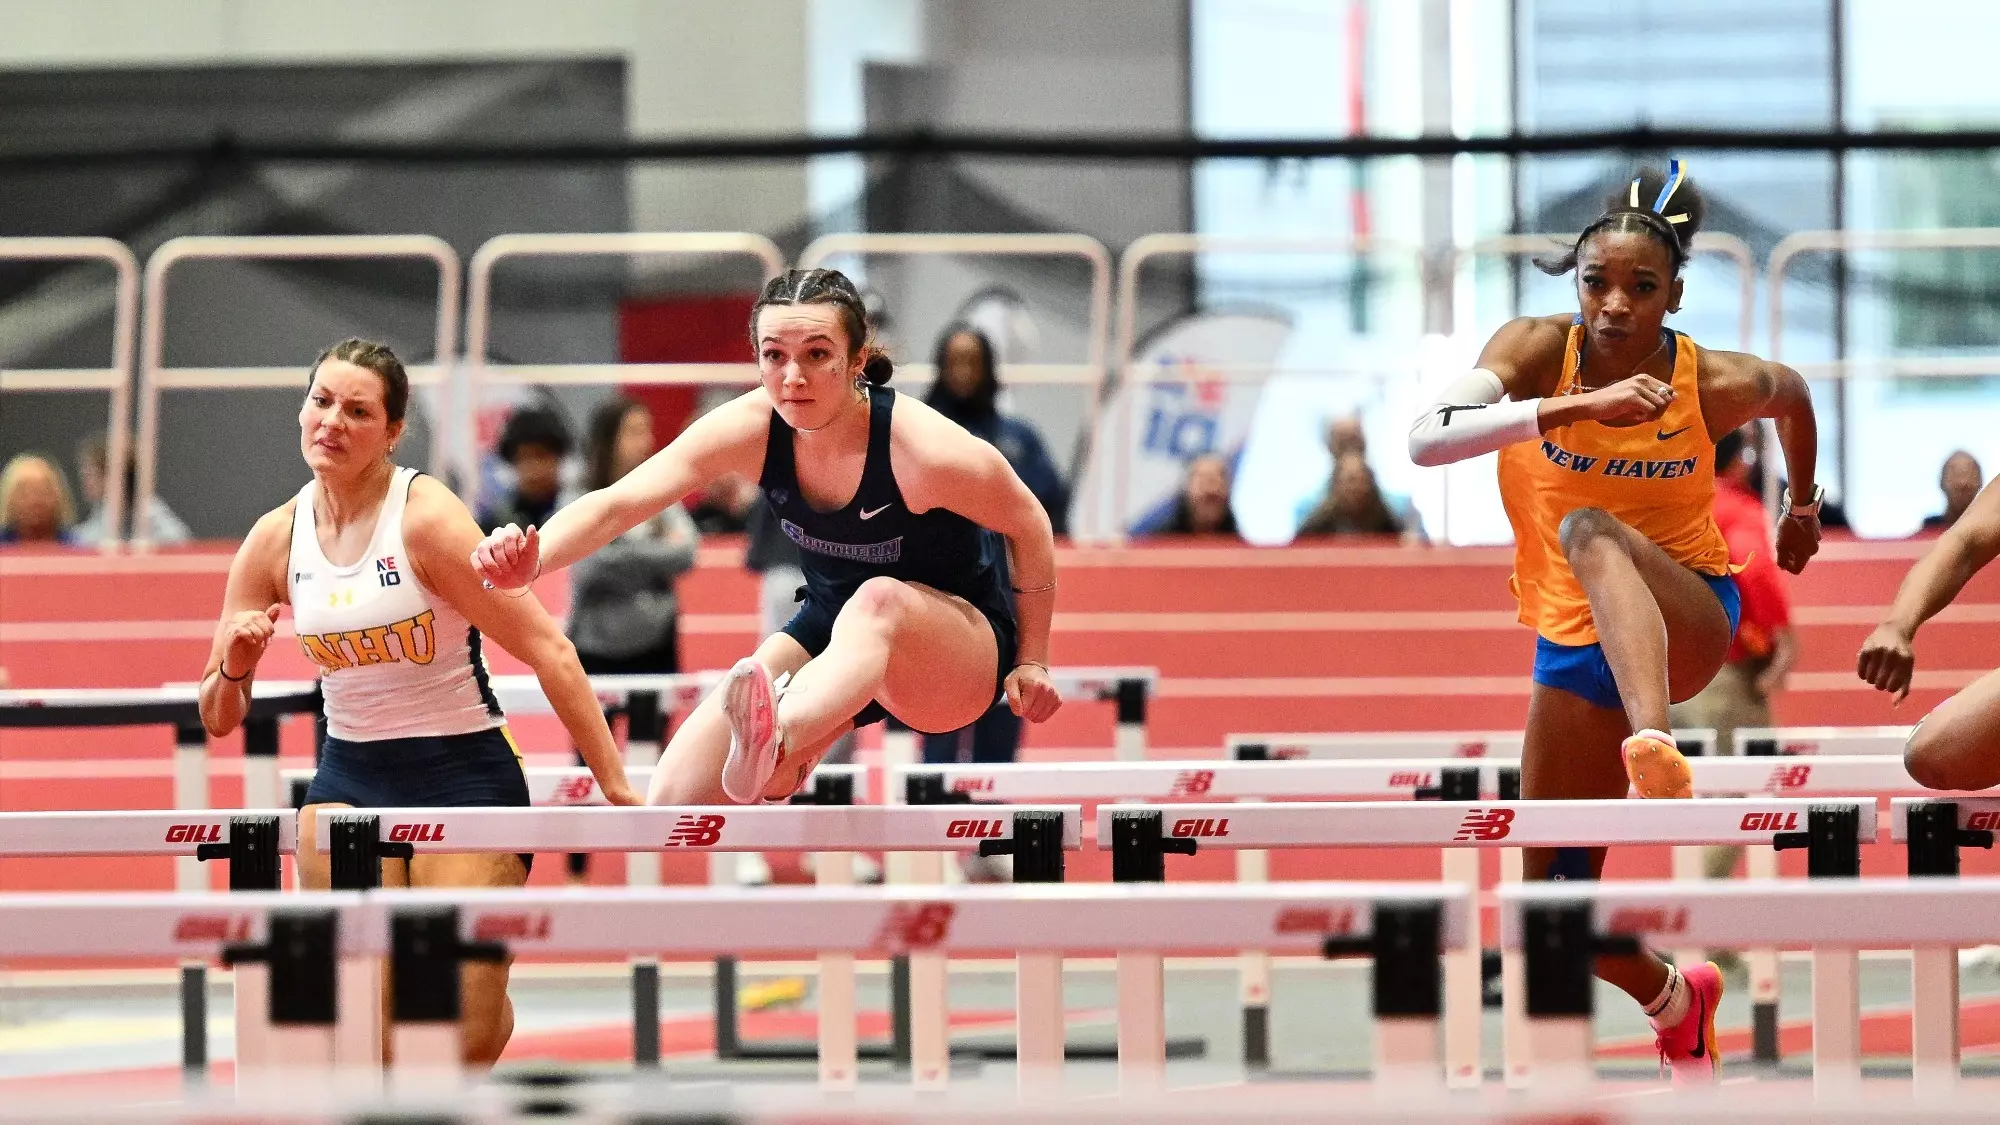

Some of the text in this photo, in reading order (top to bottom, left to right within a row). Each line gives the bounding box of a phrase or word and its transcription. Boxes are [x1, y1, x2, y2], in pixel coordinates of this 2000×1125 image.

[1540, 440, 1698, 479] NEW HAVEN
[376, 556, 395, 571] NE
[379, 571, 401, 587] 10
[297, 609, 435, 674] NHU
[946, 820, 1004, 838] GILL
[1171, 818, 1229, 837] GILL
[1453, 808, 1515, 840] NB
[1739, 812, 1798, 830] GILL
[1966, 812, 2000, 830] GI
[165, 825, 222, 842] GILL
[388, 824, 445, 841] GILL
[664, 814, 725, 847] NB
